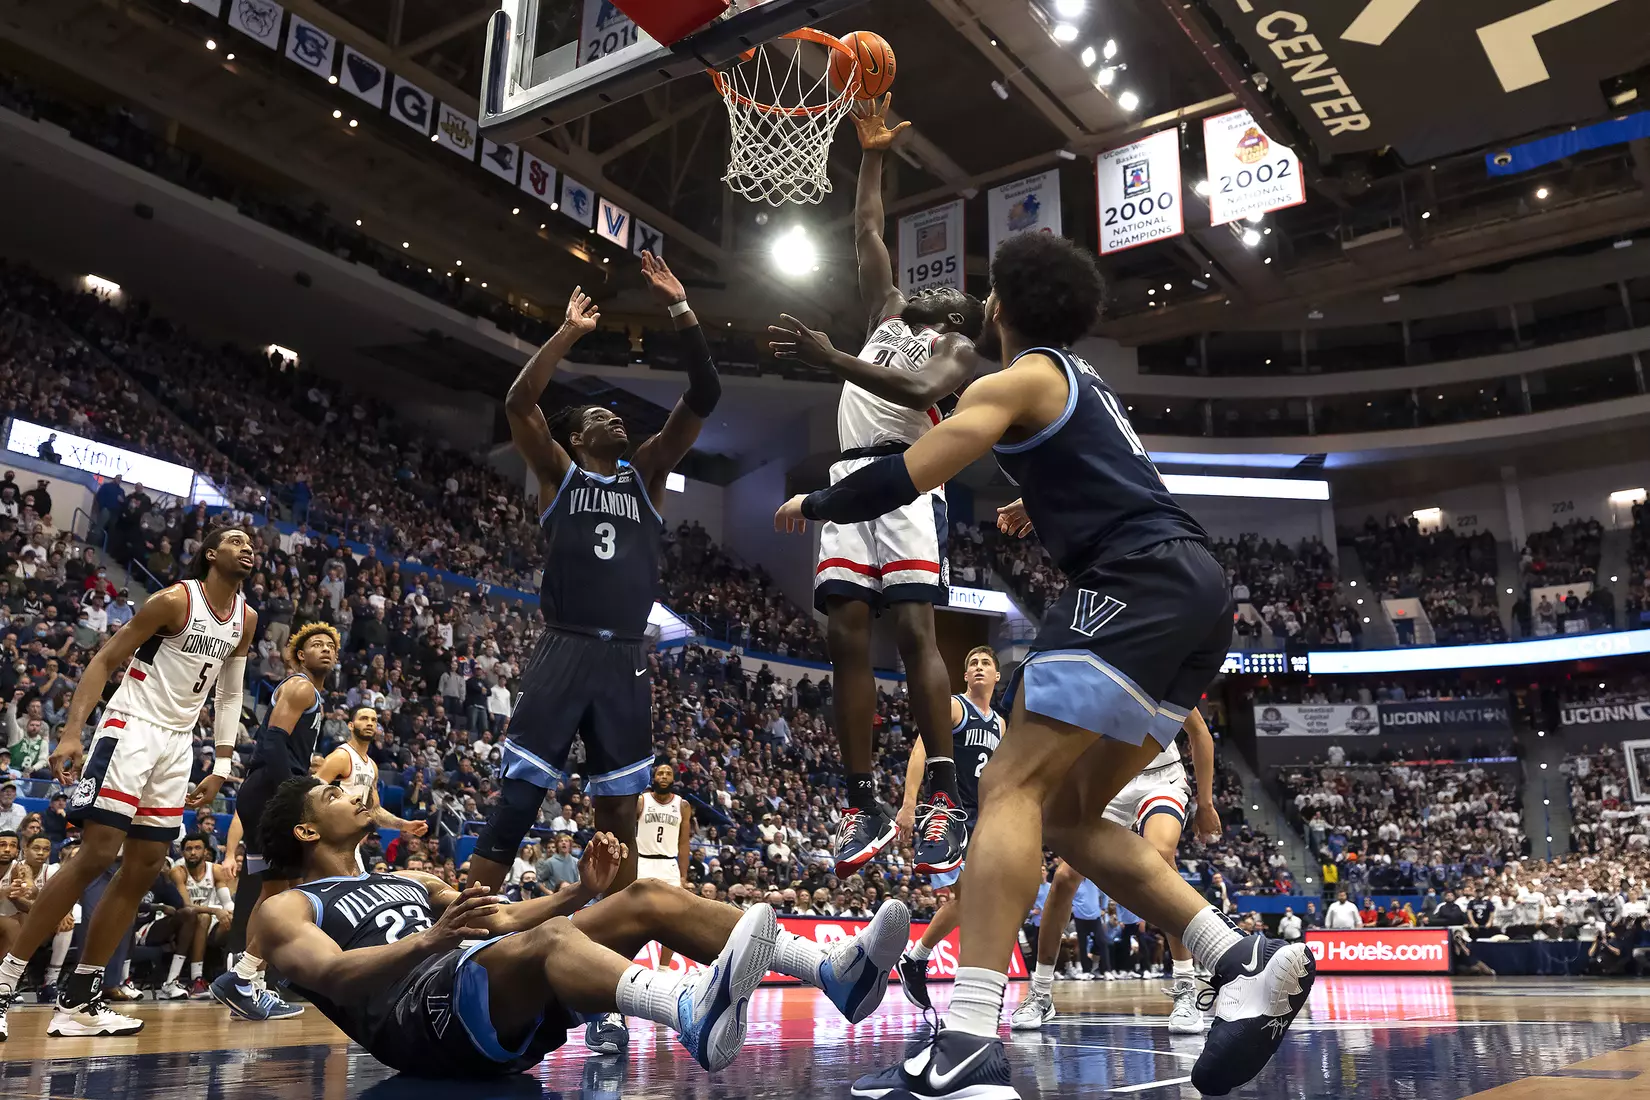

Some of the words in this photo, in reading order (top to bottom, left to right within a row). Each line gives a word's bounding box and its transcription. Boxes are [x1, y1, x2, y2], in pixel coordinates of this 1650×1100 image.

[1256, 10, 1371, 137] CENTER
[396, 85, 430, 129] G
[1103, 147, 1129, 160] UConn
[1219, 159, 1292, 194] 2002
[1223, 193, 1293, 218] CHAMPIONS
[1227, 184, 1285, 204] NATIONAL
[604, 205, 626, 238] V
[1104, 192, 1173, 227] 2000
[1108, 225, 1172, 249] CHAMPIONS
[1113, 215, 1167, 236] NATIONAL
[907, 255, 957, 284] 1995
[909, 277, 956, 295] NATIONAL
[569, 487, 641, 524] VILLANOVA
[1552, 501, 1574, 514] 224
[1457, 515, 1478, 528] 223
[594, 522, 617, 560] 3
[1070, 588, 1127, 637] V
[181, 634, 236, 661] CONNECTIC
[193, 662, 213, 694] 5
[1382, 711, 1440, 726] UCONN
[1561, 707, 1634, 725] UCONN
[964, 729, 1000, 752] VILLAN
[974, 752, 989, 778] 2
[645, 813, 679, 827] CONNECTICUT
[656, 826, 664, 843] 2
[334, 884, 431, 928] VILLANOVA
[375, 905, 432, 944] 23
[1328, 940, 1443, 961] Hotels.com
